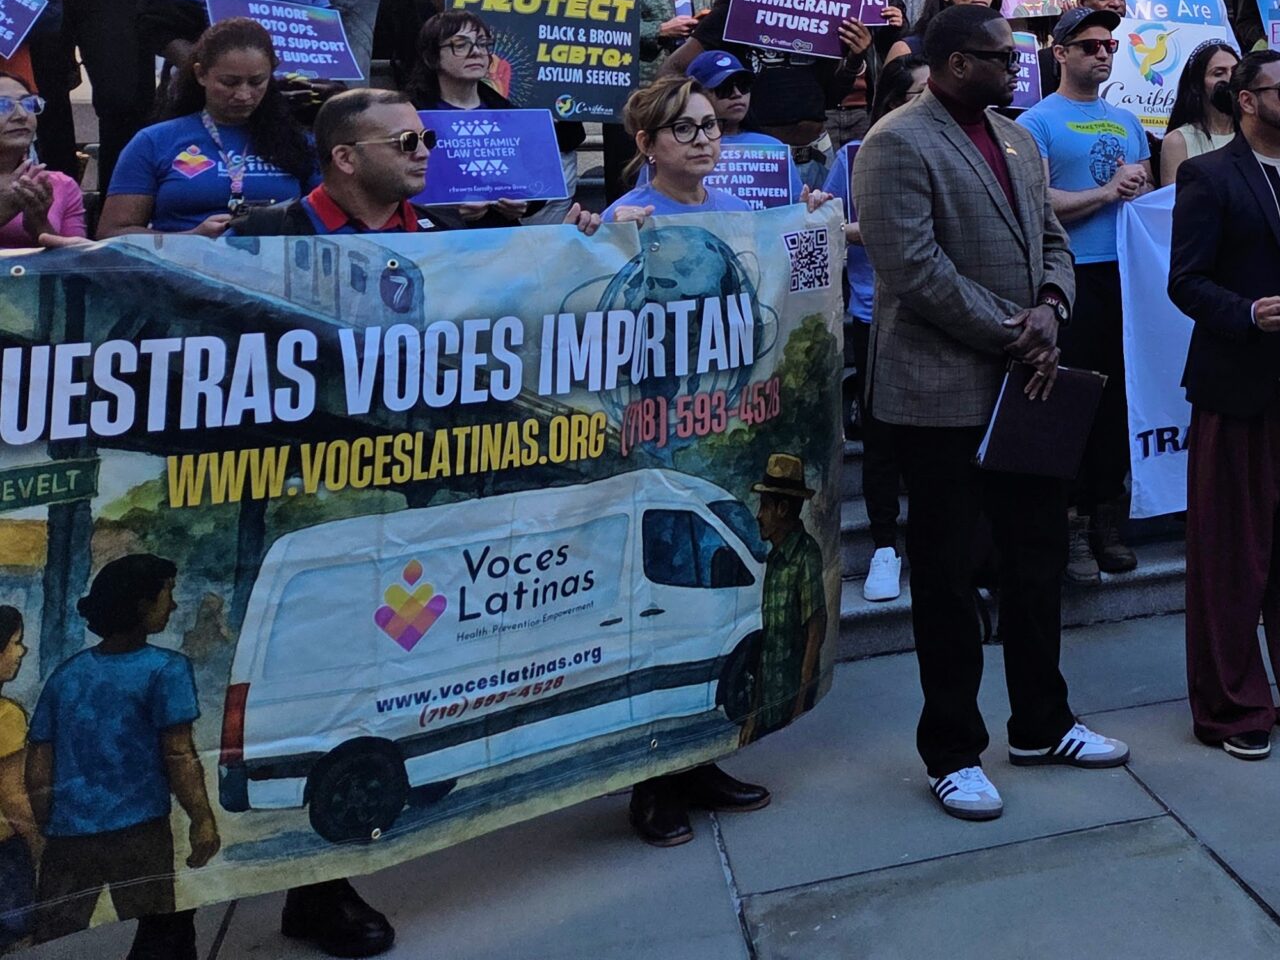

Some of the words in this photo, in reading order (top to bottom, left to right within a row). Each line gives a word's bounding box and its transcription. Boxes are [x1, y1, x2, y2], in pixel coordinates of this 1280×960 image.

[248, 2, 270, 15] NO
[272, 5, 309, 21] MORE
[1125, 1, 1168, 20] We
[1177, 0, 1212, 19] Are
[289, 23, 318, 36] OPS.
[755, 9, 829, 35] FUTURES
[288, 37, 345, 52] SUPPORT
[538, 24, 575, 41] BLACK
[577, 28, 586, 43] &
[590, 28, 632, 46] BROWN
[283, 50, 339, 64] BUDGET.
[536, 43, 633, 68] LGBTQ+
[537, 66, 583, 84] ASYLUM
[586, 69, 631, 87] SEEKERS
[436, 138, 481, 149] CHOSEN
[483, 137, 520, 147] FAMILY
[446, 149, 470, 159] LAW
[473, 147, 516, 158] CENTER
[743, 150, 764, 159] ARE
[767, 151, 786, 160] THE
[728, 162, 778, 172] BETWEEN
[731, 175, 755, 184] AND
[738, 187, 787, 198] BETWEEN
[387, 274, 409, 307] 7
[0, 329, 317, 446] UESTRAS
[337, 315, 524, 416] VOCES
[537, 292, 755, 397] IMPORTAN
[166, 412, 607, 509] WWW.VOCESLATINAS.ORG
[621, 395, 668, 457] (718)
[676, 376, 780, 438] 593-4528
[2, 469, 81, 502] EVELT
[462, 544, 569, 585] Voces
[458, 569, 595, 622] Latinas
[456, 627, 488, 642] Health
[492, 619, 540, 635] Prevention
[542, 600, 594, 623] Empowerment
[376, 645, 602, 713] www.voceslatinas.org
[418, 694, 469, 728] (718)
[472, 675, 565, 710] 593-4528
